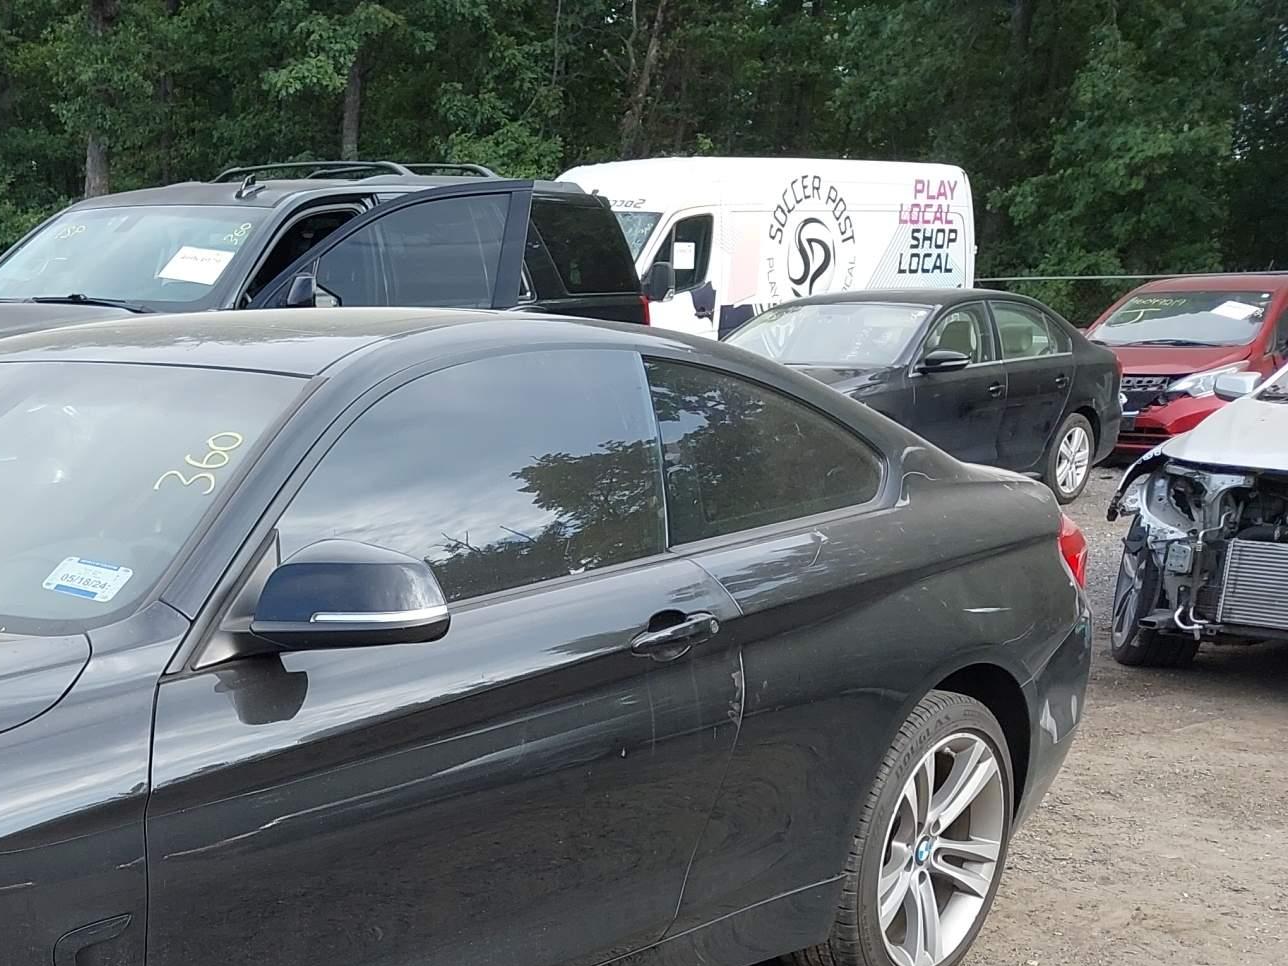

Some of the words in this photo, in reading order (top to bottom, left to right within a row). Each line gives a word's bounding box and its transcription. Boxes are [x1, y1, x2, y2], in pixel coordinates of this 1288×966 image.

[914, 179, 958, 200] PLAY
[769, 174, 822, 245] SOCCER
[825, 185, 856, 245] POST
[898, 203, 954, 225] LOCAL
[909, 228, 958, 249] SHOP
[897, 252, 953, 274] LOCAL
[153, 431, 243, 496] 360
